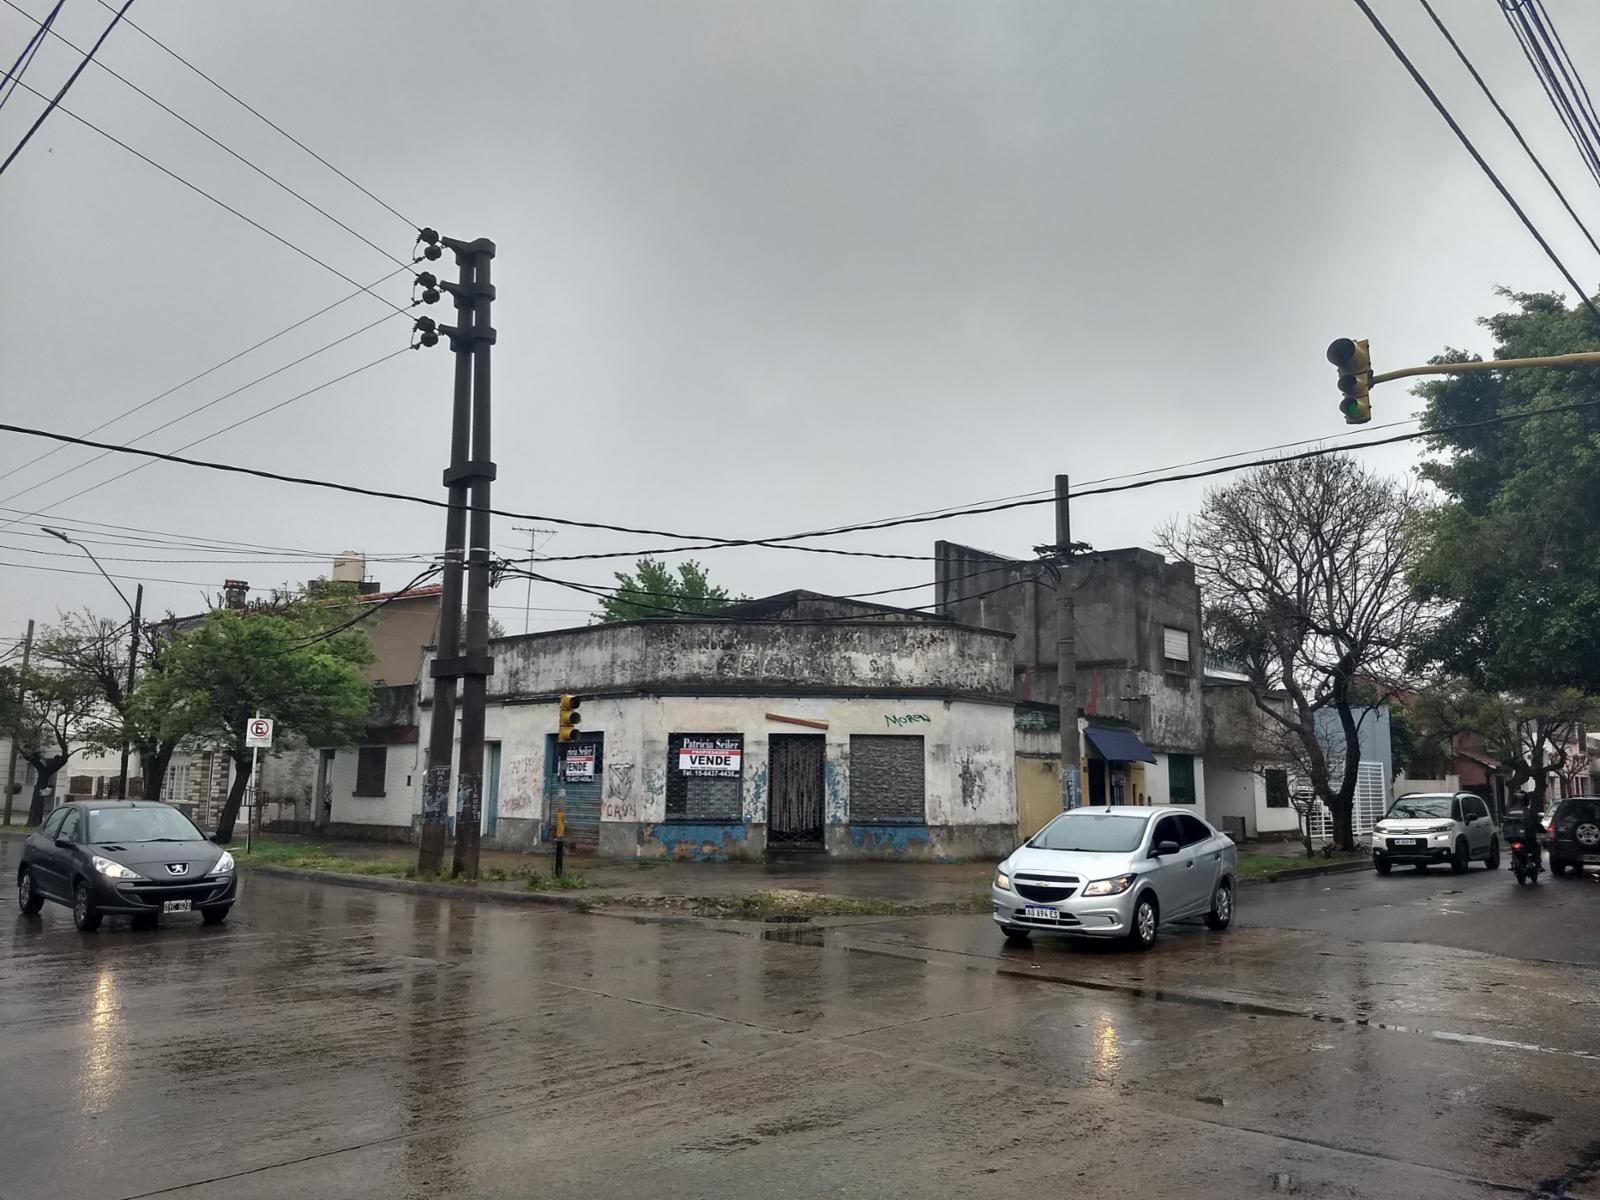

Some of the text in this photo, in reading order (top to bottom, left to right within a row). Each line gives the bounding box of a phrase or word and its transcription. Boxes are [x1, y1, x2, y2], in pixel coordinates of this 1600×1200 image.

[683, 738, 739, 749] Patricia Seiler
[689, 755, 732, 766] VENDE
[568, 762, 588, 772] ENDE
